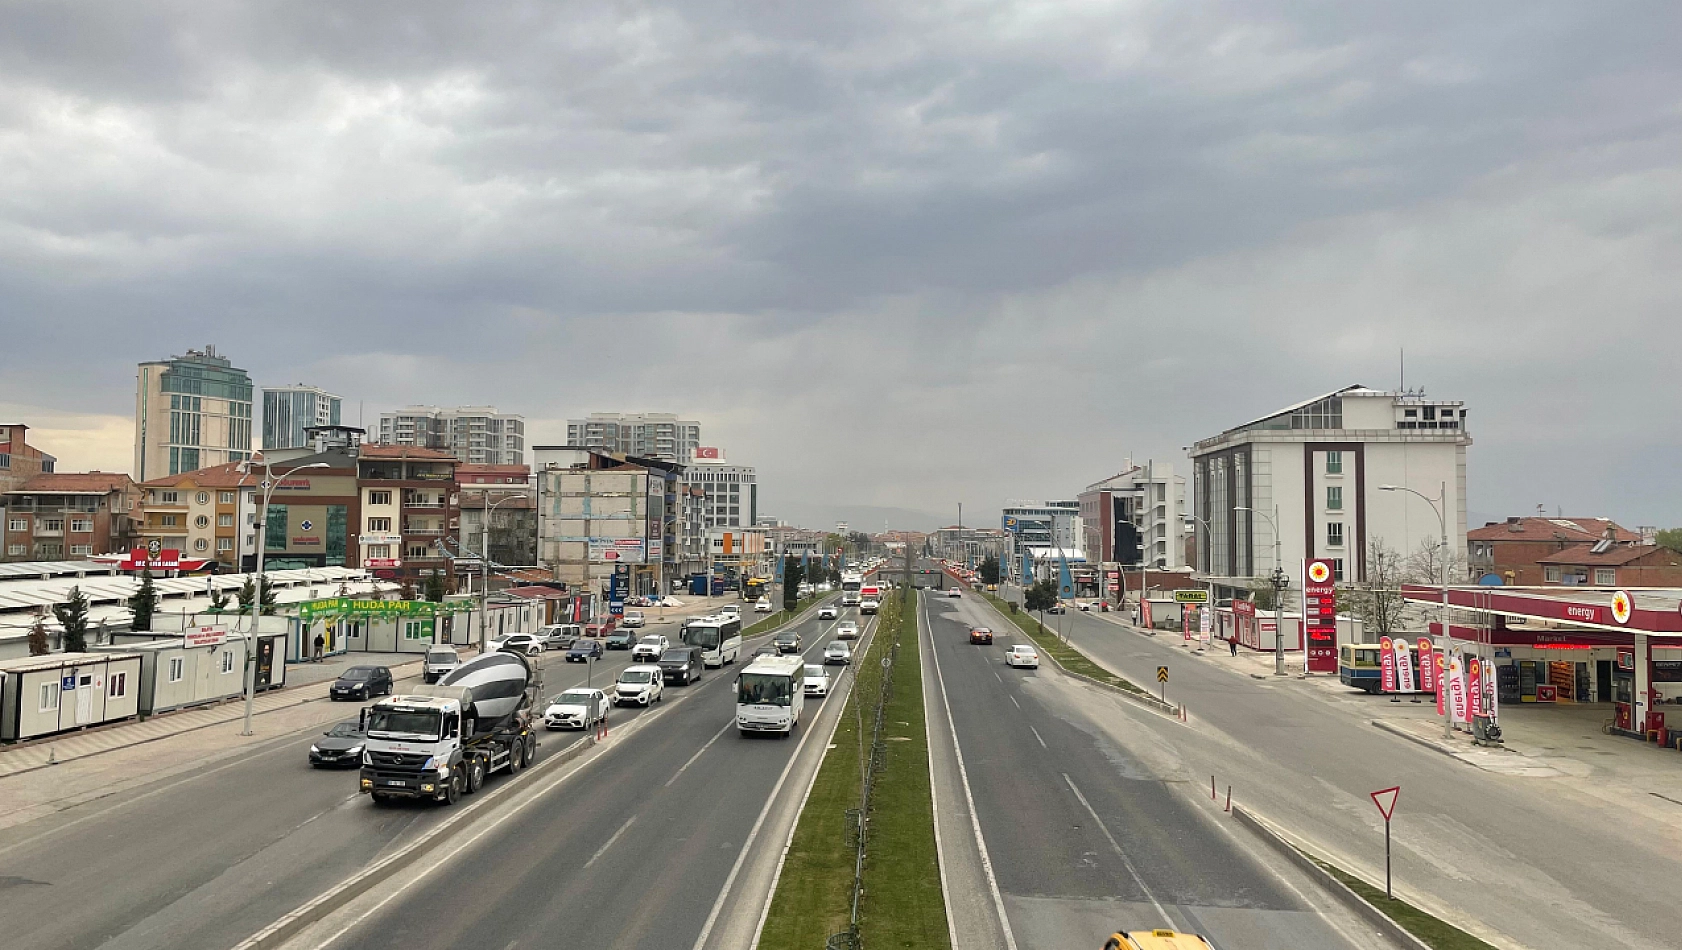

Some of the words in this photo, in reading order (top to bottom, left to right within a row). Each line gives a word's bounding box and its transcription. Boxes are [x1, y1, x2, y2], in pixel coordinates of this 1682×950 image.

[1306, 586, 1333, 594] energy
[353, 601, 385, 609] HUDA
[388, 601, 410, 610] PAR
[1567, 606, 1594, 620] energy
